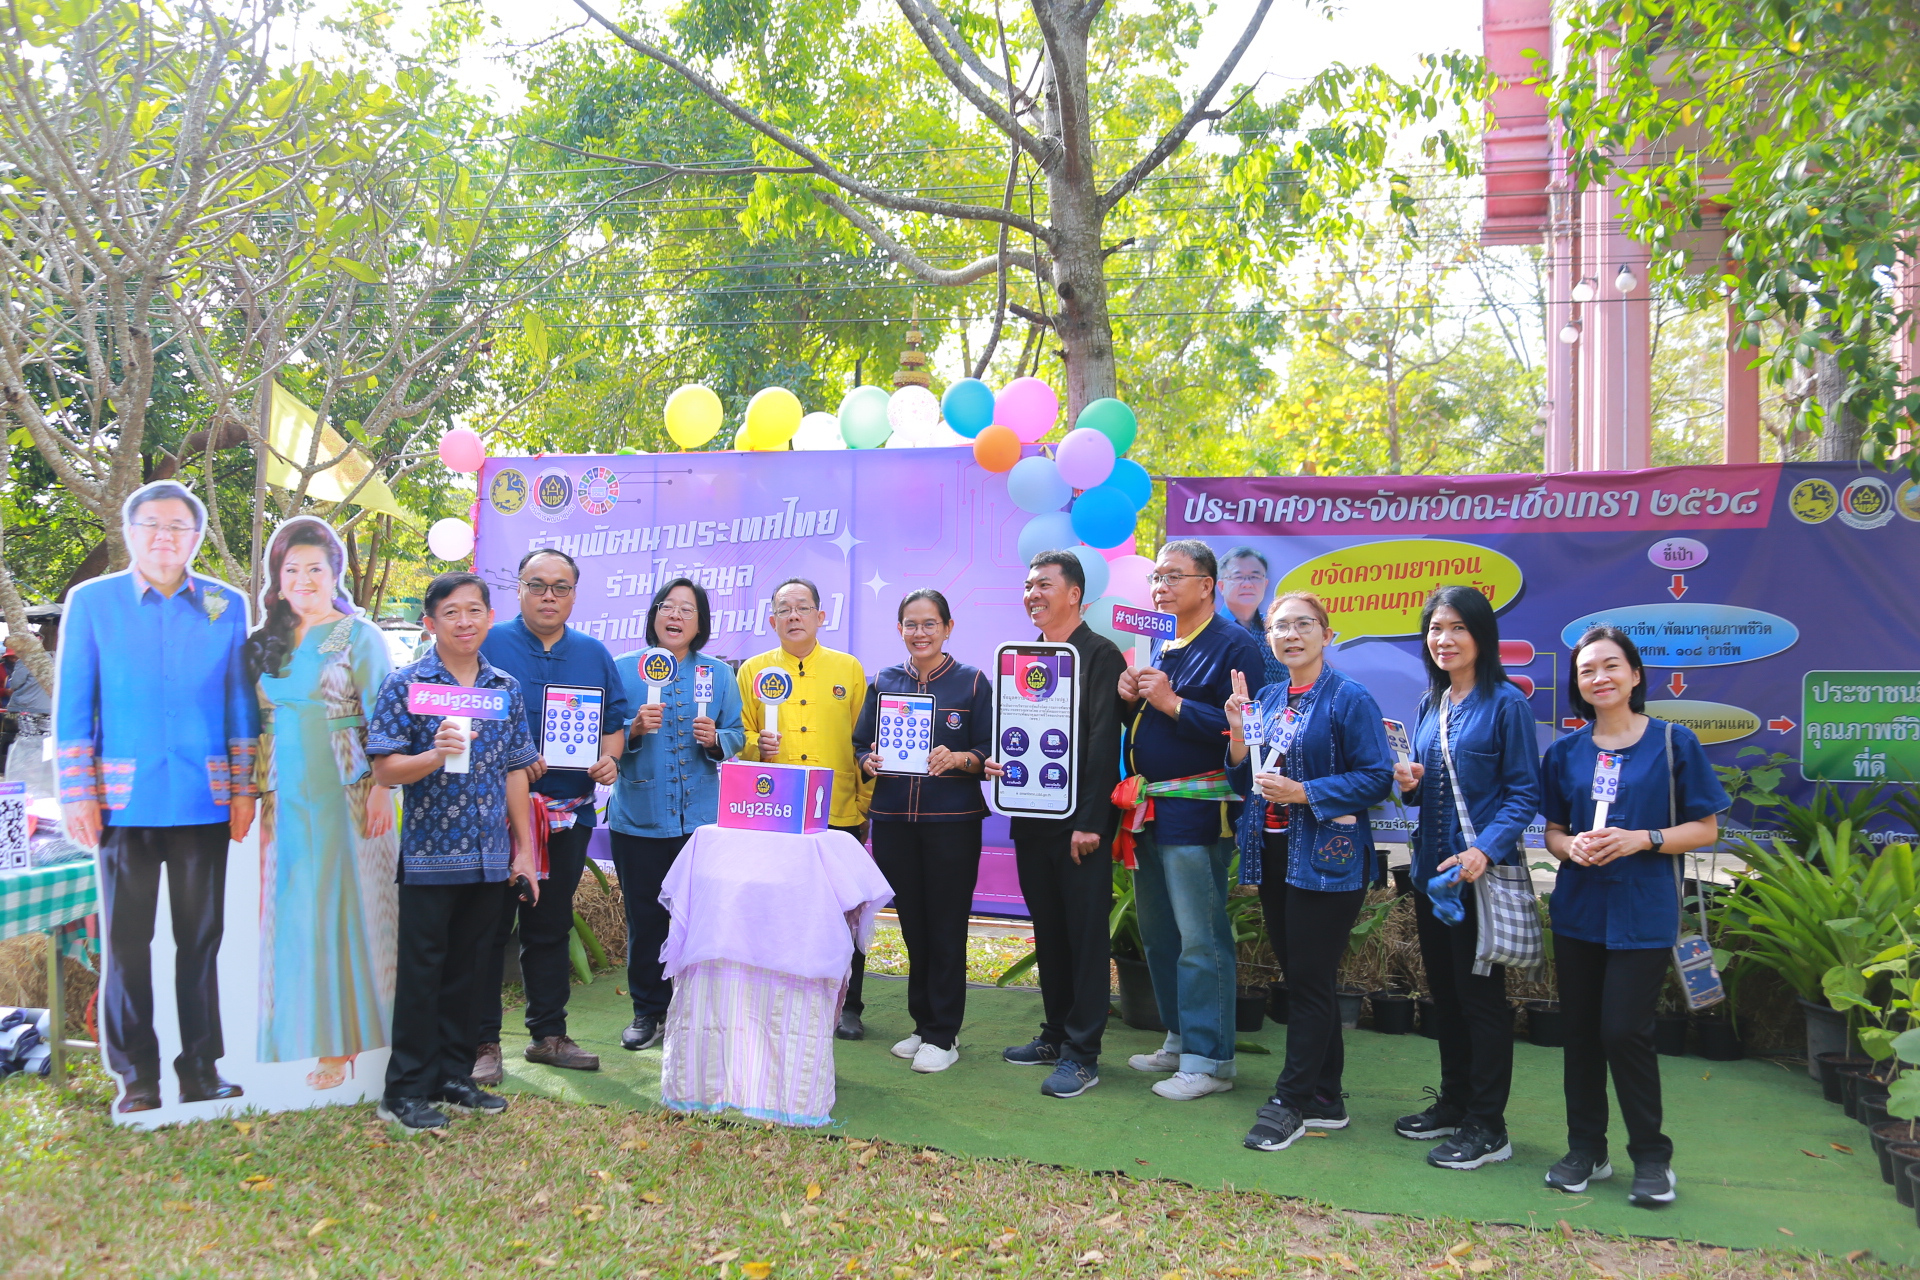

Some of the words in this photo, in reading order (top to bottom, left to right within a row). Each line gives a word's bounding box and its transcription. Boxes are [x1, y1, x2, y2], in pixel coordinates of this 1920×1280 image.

[1184, 486, 1640, 524] ประกาศวาระจังหวัดฉะเชิงเทรา
[1650, 487, 1760, 517] ๒๕๖๘
[1663, 543, 1693, 561] ชี้เป้า
[1310, 555, 1482, 587] ขจัดความยากจน
[1115, 610, 1173, 633] #จปฐ2568
[1676, 647, 1702, 656] ๑๐๘
[1709, 642, 1741, 656] อาชีพ
[415, 690, 504, 711] #จปฐ2568
[1853, 746, 1886, 777] ที่ดี
[729, 802, 792, 818] จปฐ2568
